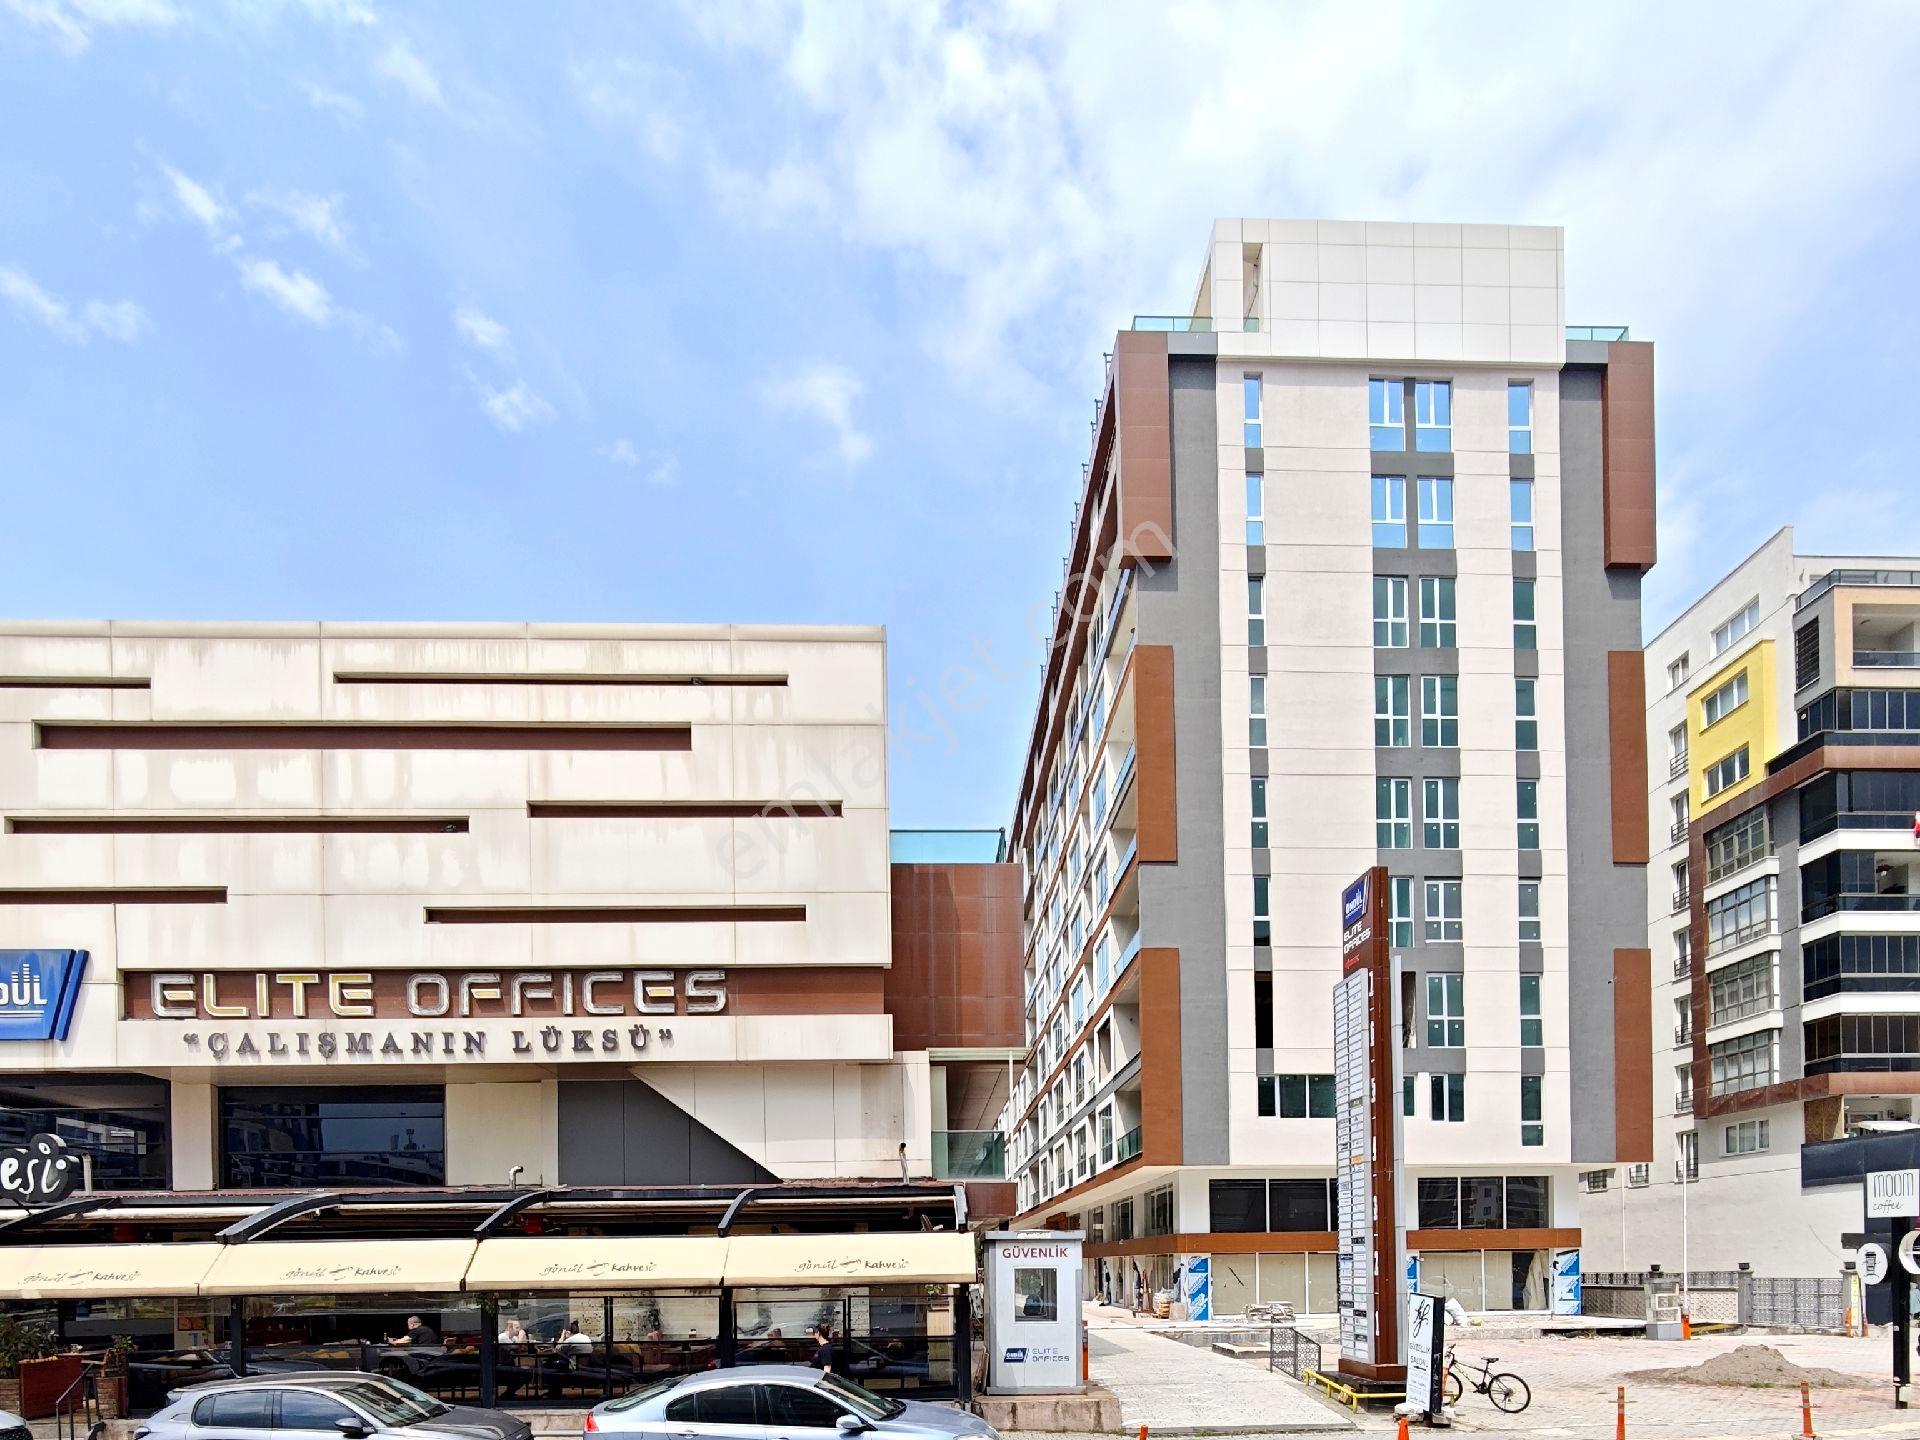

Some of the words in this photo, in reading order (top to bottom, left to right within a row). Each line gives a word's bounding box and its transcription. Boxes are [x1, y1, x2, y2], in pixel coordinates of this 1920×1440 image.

[1343, 921, 1363, 942] ELITE
[151, 973, 374, 1018] ELITE
[406, 970, 727, 1017] OFFICES
[1872, 1199, 1904, 1214] coffee
[1002, 1244, 1069, 1259] GÜVENLİK
[1032, 1355, 1070, 1363] OFFICES
